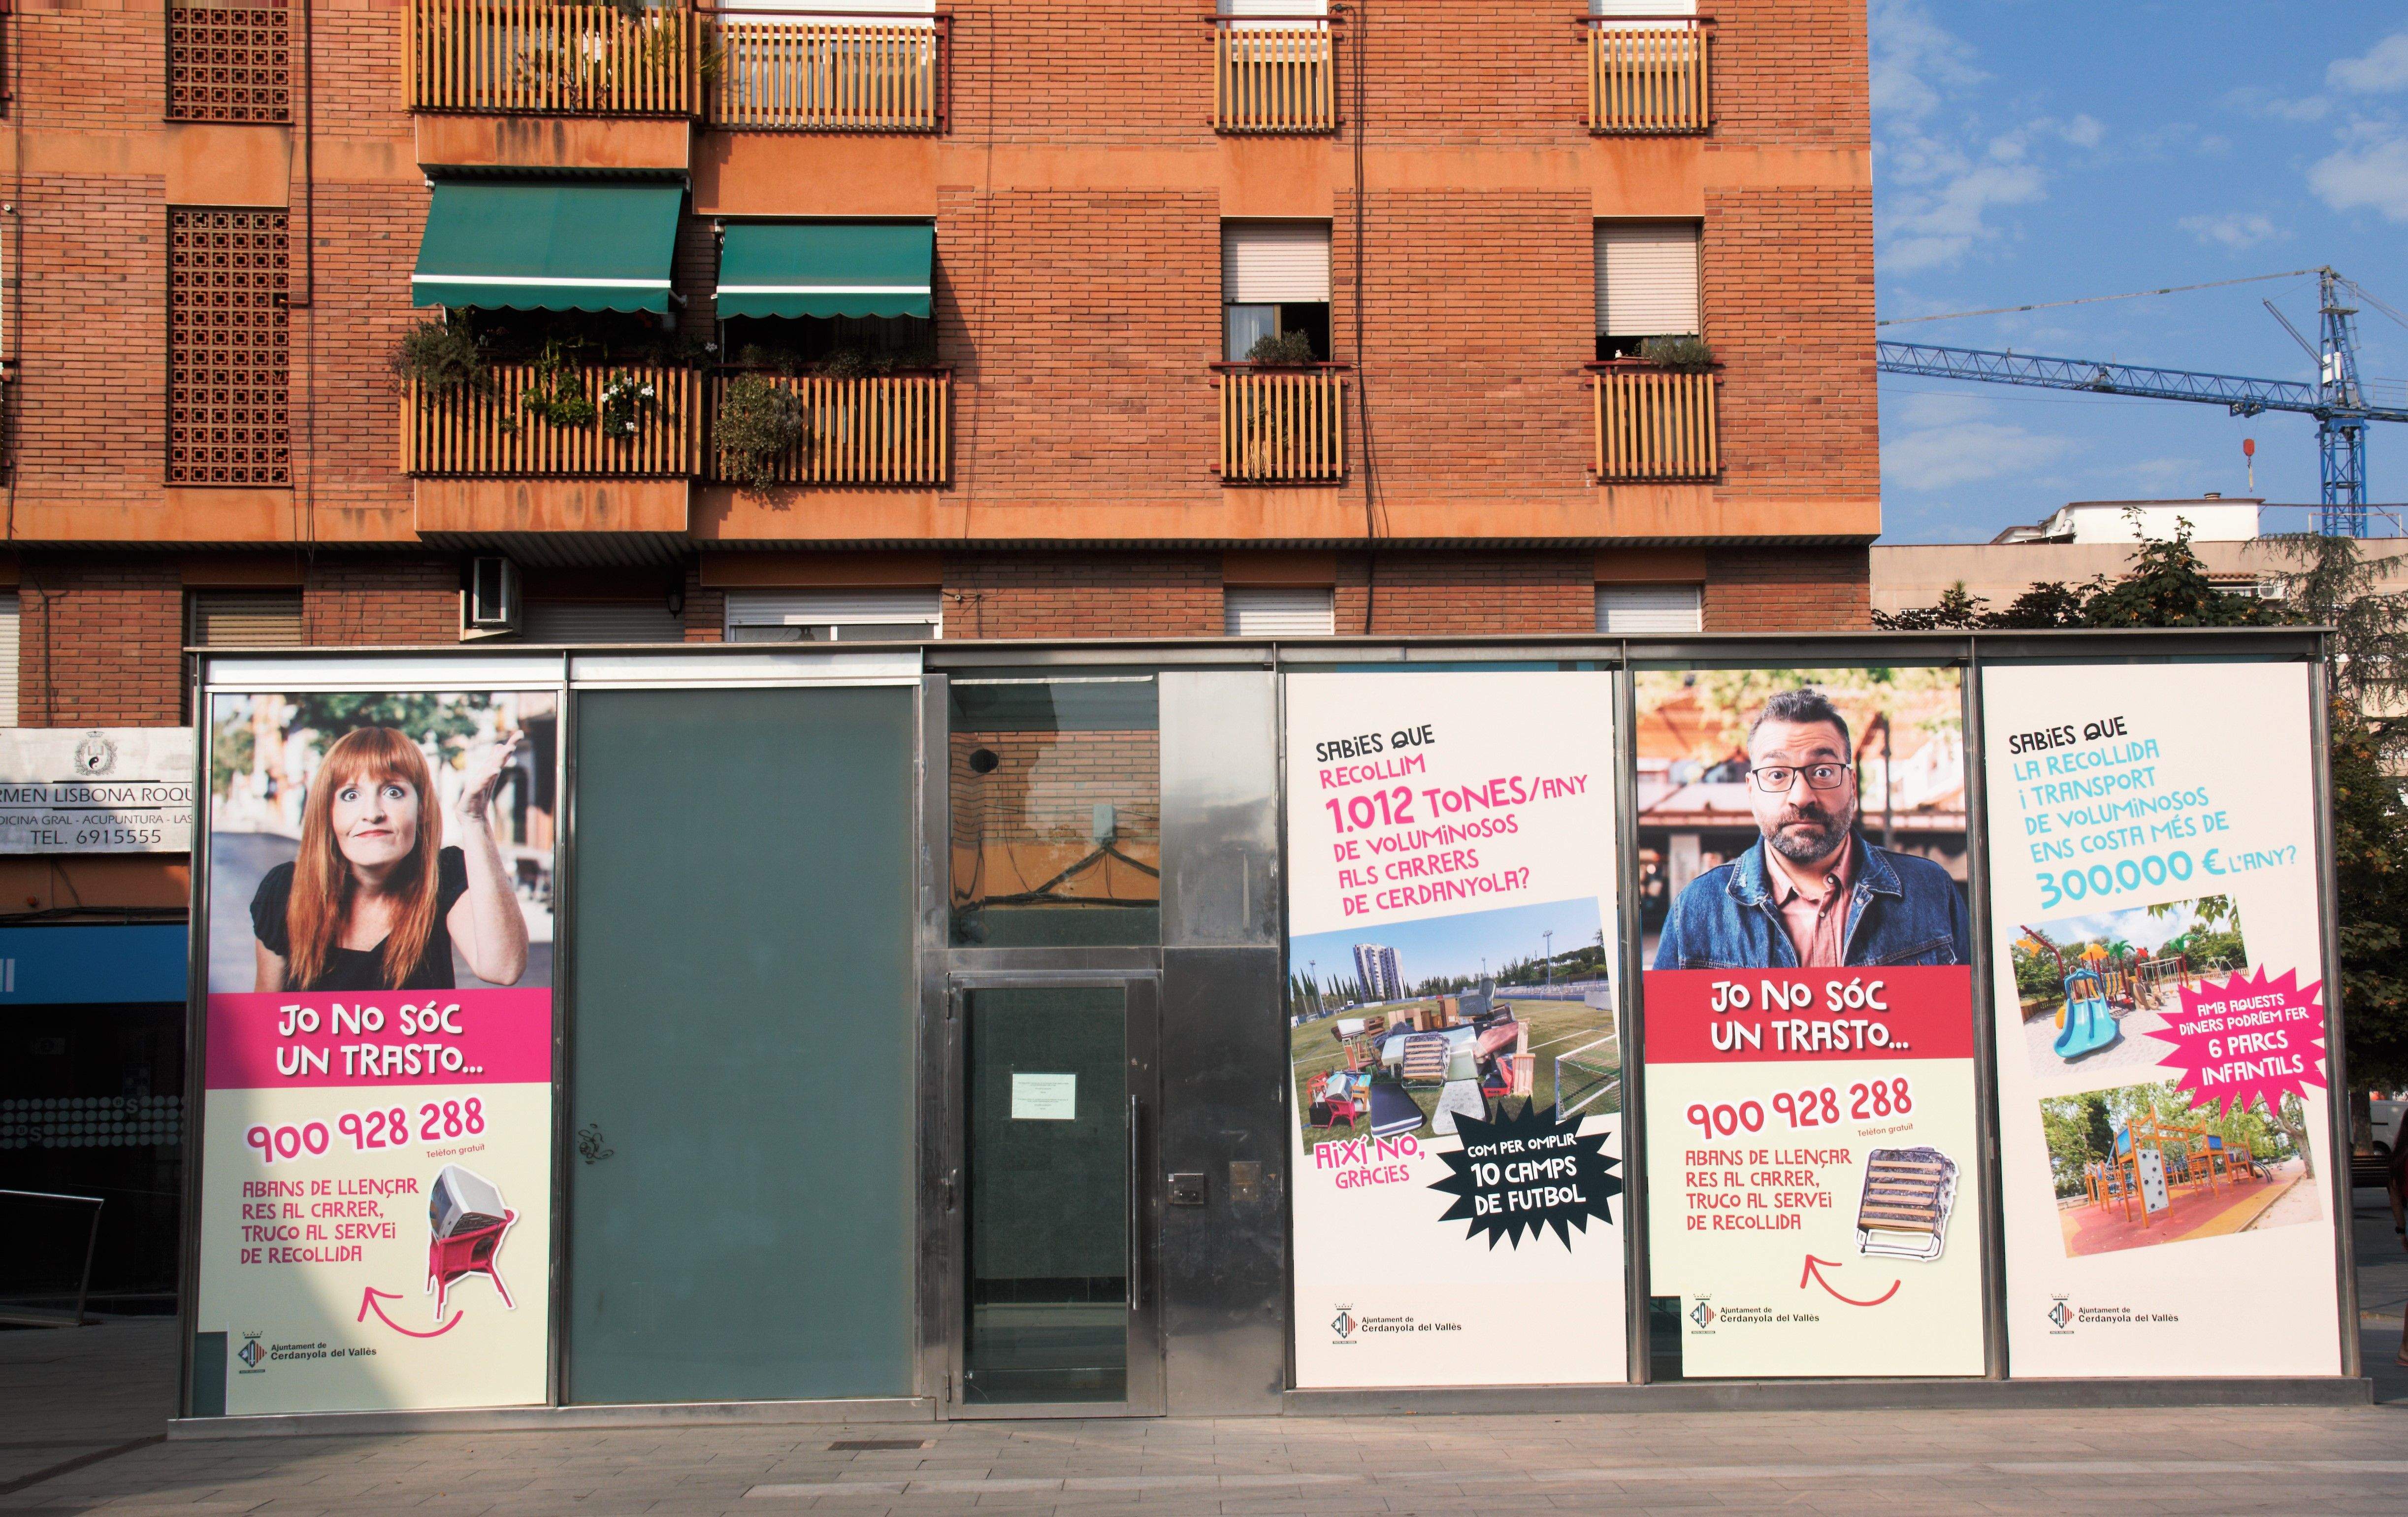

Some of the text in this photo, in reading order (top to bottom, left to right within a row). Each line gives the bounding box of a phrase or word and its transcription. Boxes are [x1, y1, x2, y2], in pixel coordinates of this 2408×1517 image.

[1391, 724, 1435, 749] QUE
[2083, 716, 2128, 741] QUE
[1319, 753, 1426, 789] RECOLLIM
[2014, 738, 2160, 782] LA RECOLLIDA
[55, 788, 135, 802] LISBONA
[2030, 766, 2155, 806] TRANSPORT
[41, 815, 73, 825] GRAL
[82, 814, 163, 825] ACUPUNTURA
[2024, 813, 2052, 836] DE
[30, 829, 162, 845] TEL. 6915555
[2030, 810, 2230, 864] ENS COSTA MÉS DE
[1333, 840, 1361, 862] DE
[1338, 848, 1479, 889] ALS CARRERS
[2036, 850, 2193, 910] 300.000
[1343, 866, 1529, 917] DE CERDANYOLA?
[1711, 977, 1887, 1012] JO NO SÓC
[2197, 993, 2285, 1017] AMB AQUESTS
[279, 1000, 462, 1036] JO NO SÓC
[2226, 1010, 2282, 1030] PODRÍEM
[2285, 1006, 2310, 1021] FER
[1711, 1020, 1761, 1051] UN
[2208, 1029, 2288, 1058] 6 PARCS
[277, 1045, 329, 1076] UN
[2202, 1054, 2304, 1086] INFANTILS
[1687, 1077, 1912, 1139] 900 928 288
[248, 1097, 485, 1163] 900 928 288
[1857, 1127, 1886, 1137] Telèfon
[426, 1148, 456, 1158] Telèfon
[1376, 1136, 1425, 1161] NO,
[1467, 1133, 1577, 1157] COM PER OMPLIR
[1685, 1148, 1853, 1168] ABANS DE LLENÇAR
[1470, 1155, 1577, 1187] 10 CAMPS
[1686, 1169, 1820, 1188] RES AL CARRER,
[243, 1177, 419, 1198] ABANS DE LLENÇAR
[242, 1199, 384, 1220] RES AL CARRER,
[1474, 1184, 1586, 1216] DE FUTBOL
[1686, 1192, 1741, 1209] TRUCO
[1747, 1192, 1768, 1209] AL
[242, 1224, 301, 1242] TRUCO
[306, 1223, 328, 1241] AL
[1687, 1214, 1801, 1231] DE RECOLLIDA
[241, 1245, 363, 1265] DE RECOLLIDA
[1362, 1323, 1414, 1333] Cerdanyola
[1720, 1314, 1772, 1324] Cerdanyola
[1792, 1314, 1820, 1322] Vallès
[2079, 1315, 2131, 1323] Cerdanyola
[271, 1343, 315, 1352] Ajuntament
[271, 1347, 377, 1360] Cerdanyola del Vallès
